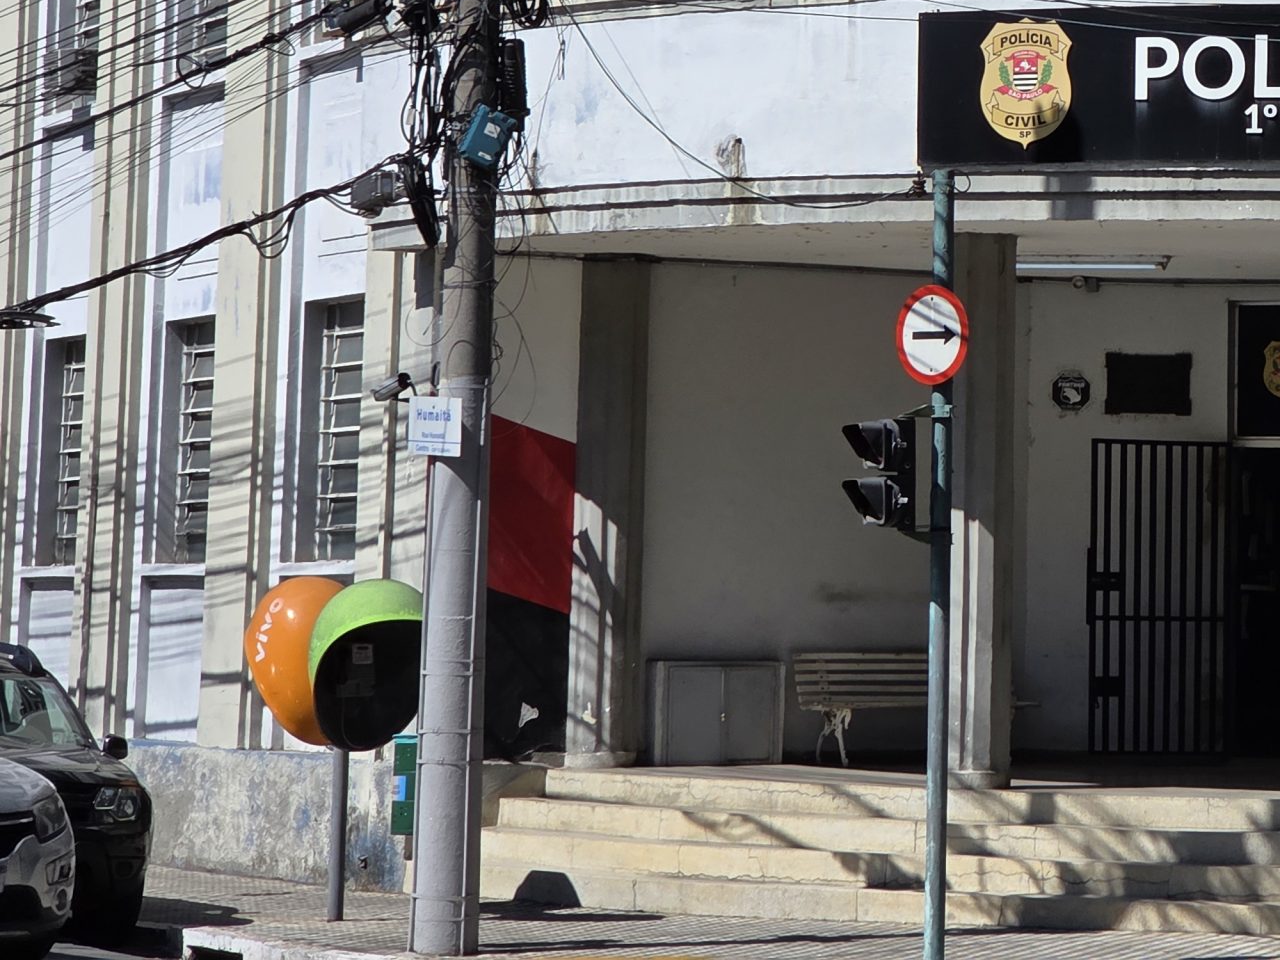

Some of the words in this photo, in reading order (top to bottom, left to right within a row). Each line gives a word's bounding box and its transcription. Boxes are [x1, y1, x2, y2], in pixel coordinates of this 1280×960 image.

[1000, 30, 1052, 48] POLÍCIA
[1022, 88, 1043, 99] PAULO
[1004, 115, 1046, 128] CIVIL
[255, 597, 283, 662] vivo
